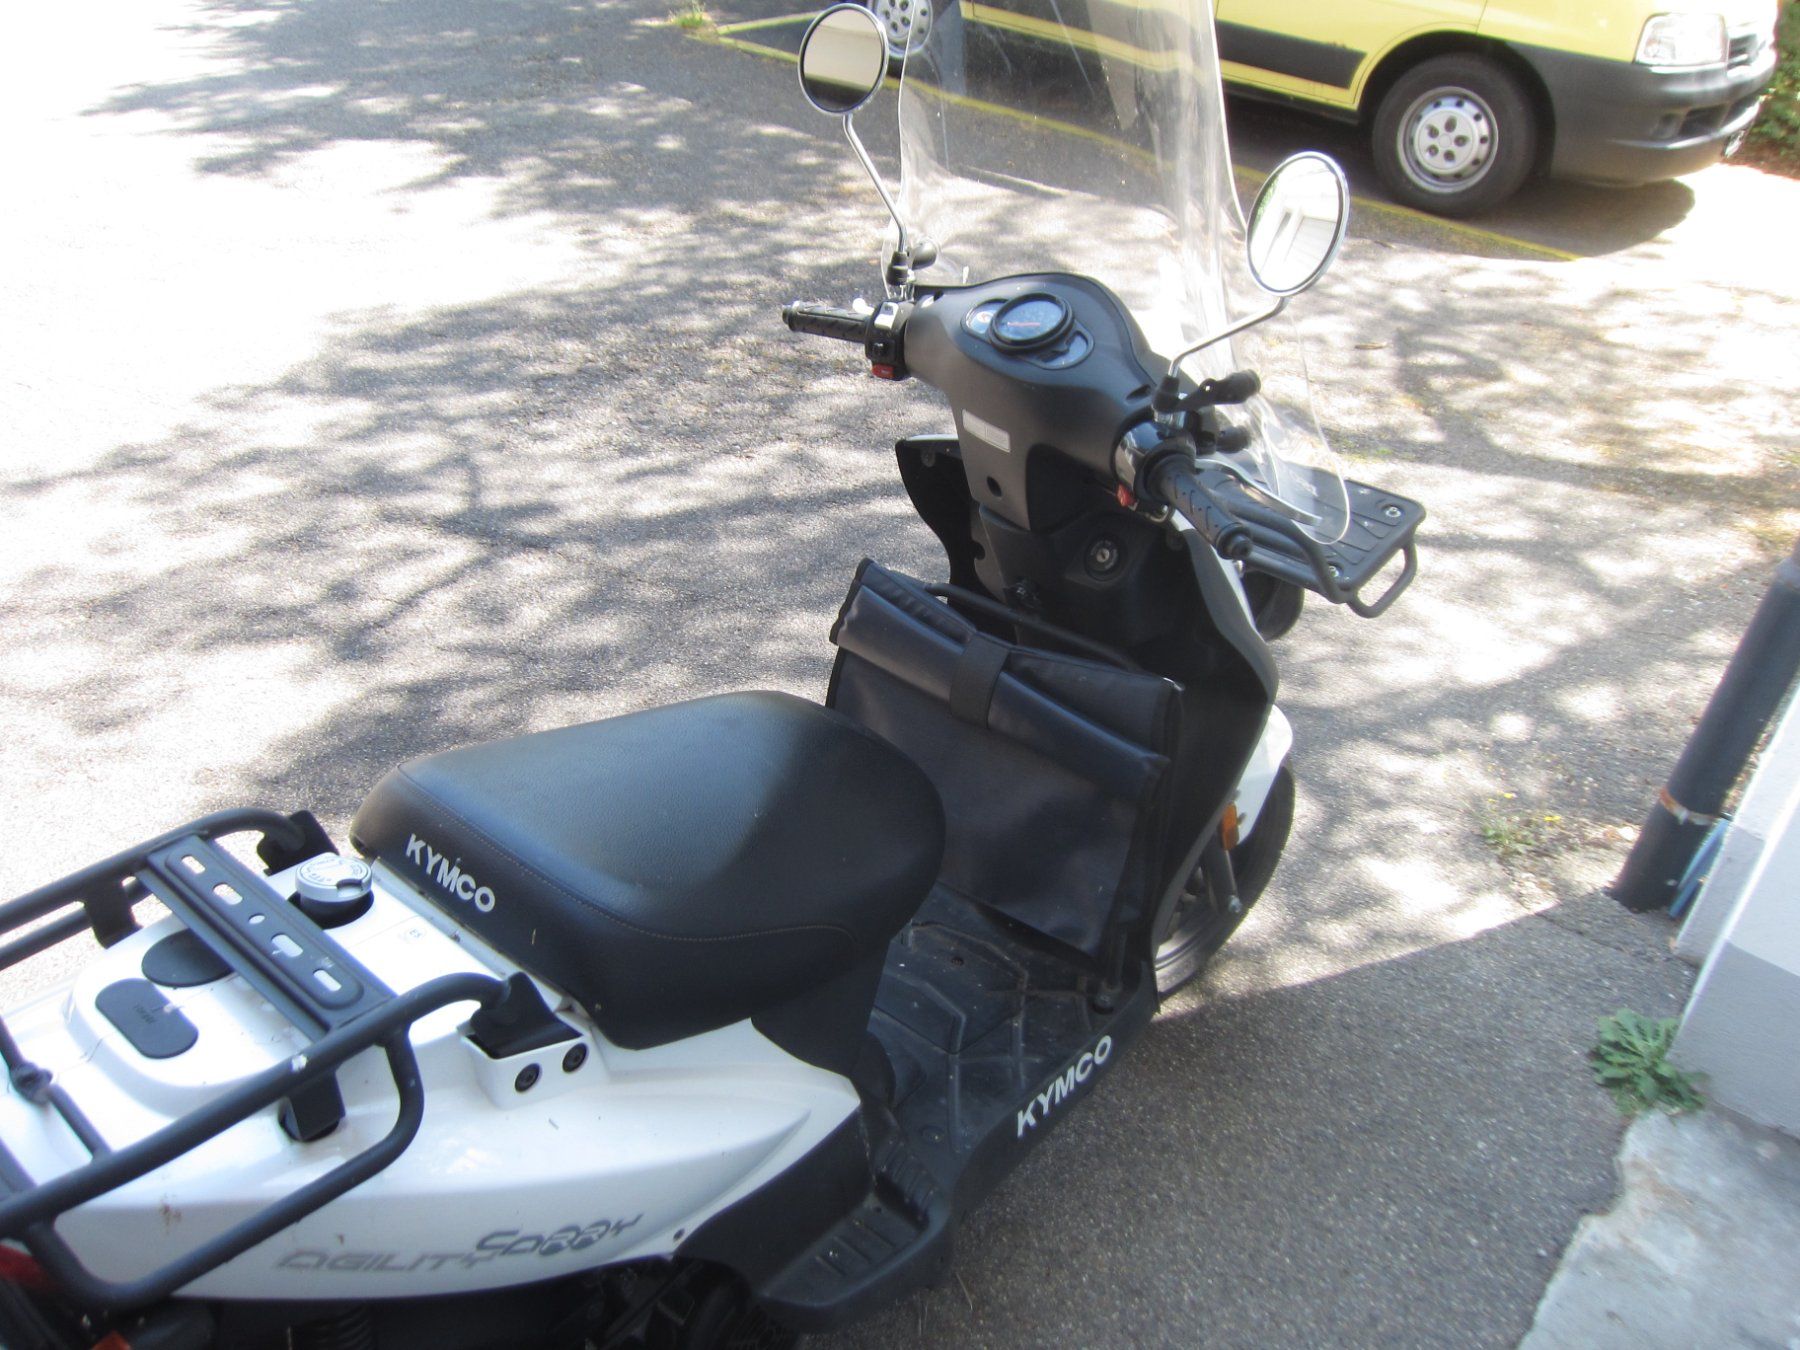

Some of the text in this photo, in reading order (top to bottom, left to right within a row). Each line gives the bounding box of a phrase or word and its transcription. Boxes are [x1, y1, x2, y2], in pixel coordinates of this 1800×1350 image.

[406, 833, 495, 912] KYMCO
[1017, 1035, 1112, 1138] KYMCO
[276, 1250, 497, 1271] AGILITY
